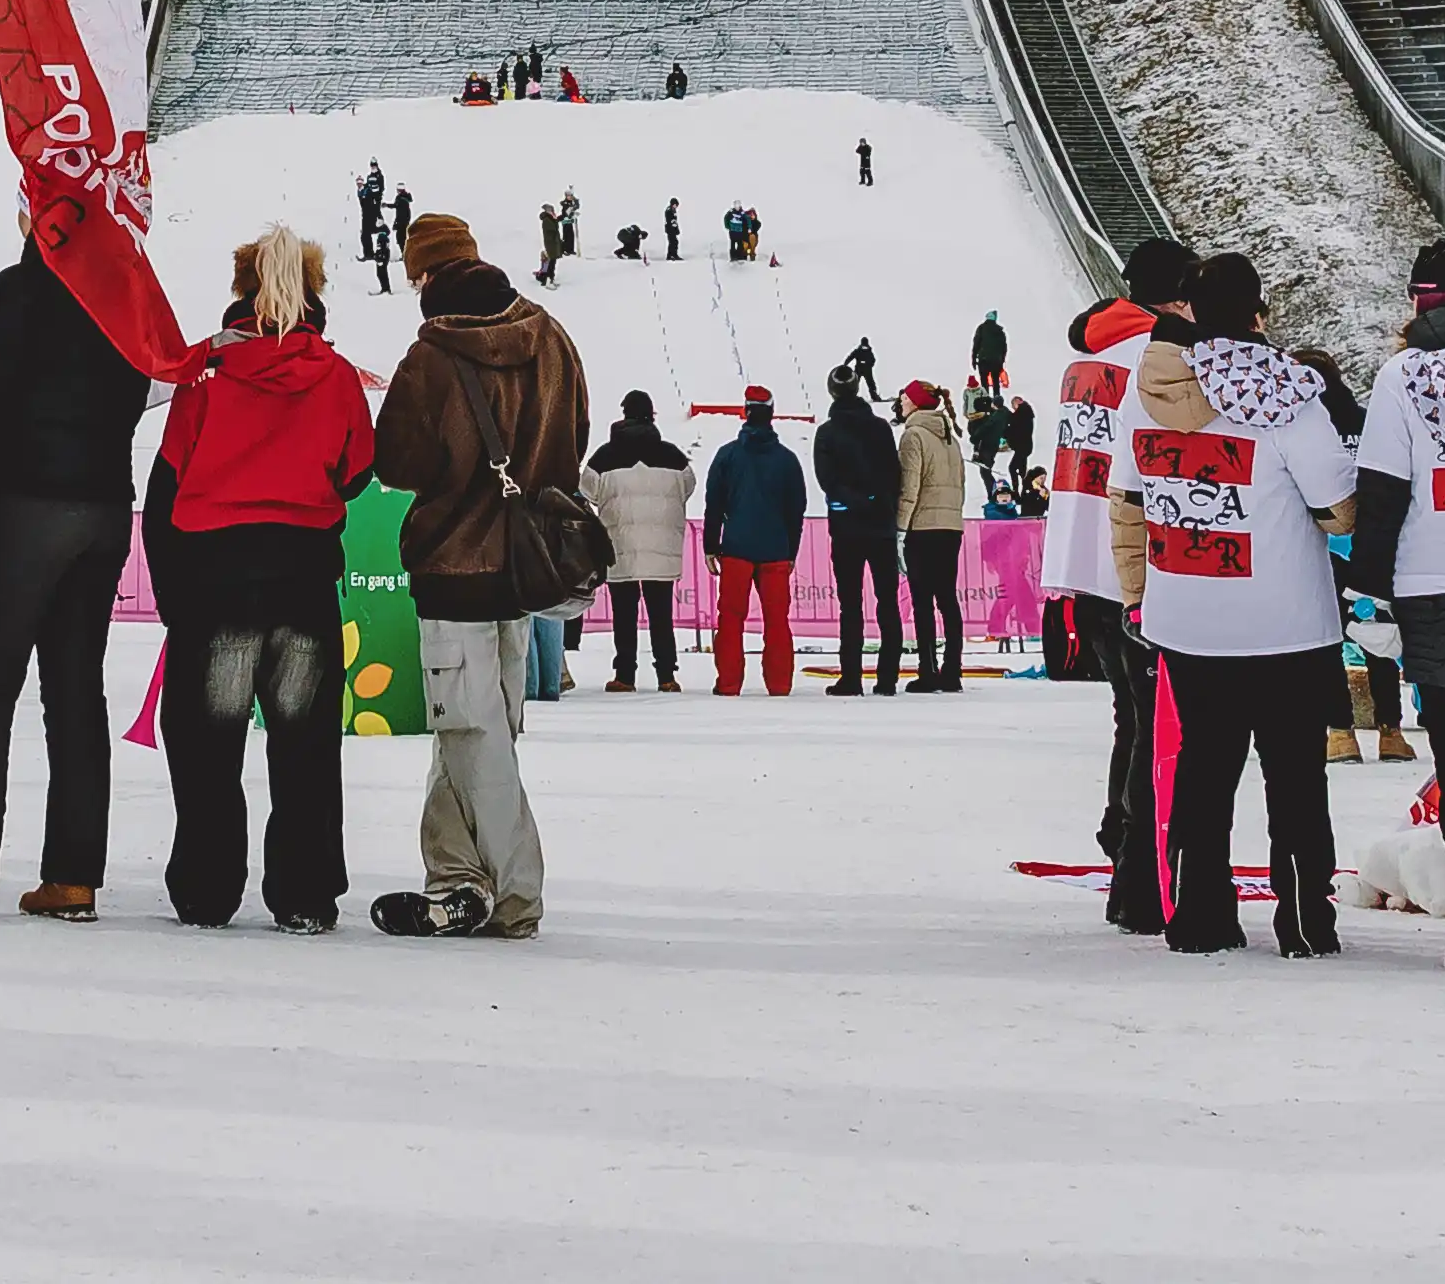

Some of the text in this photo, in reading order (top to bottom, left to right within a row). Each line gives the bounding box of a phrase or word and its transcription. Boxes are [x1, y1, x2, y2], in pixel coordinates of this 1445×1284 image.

[351, 571, 366, 587] En
[368, 575, 396, 592] gang
[793, 584, 837, 601] BAR
[958, 583, 1008, 601] RNE
